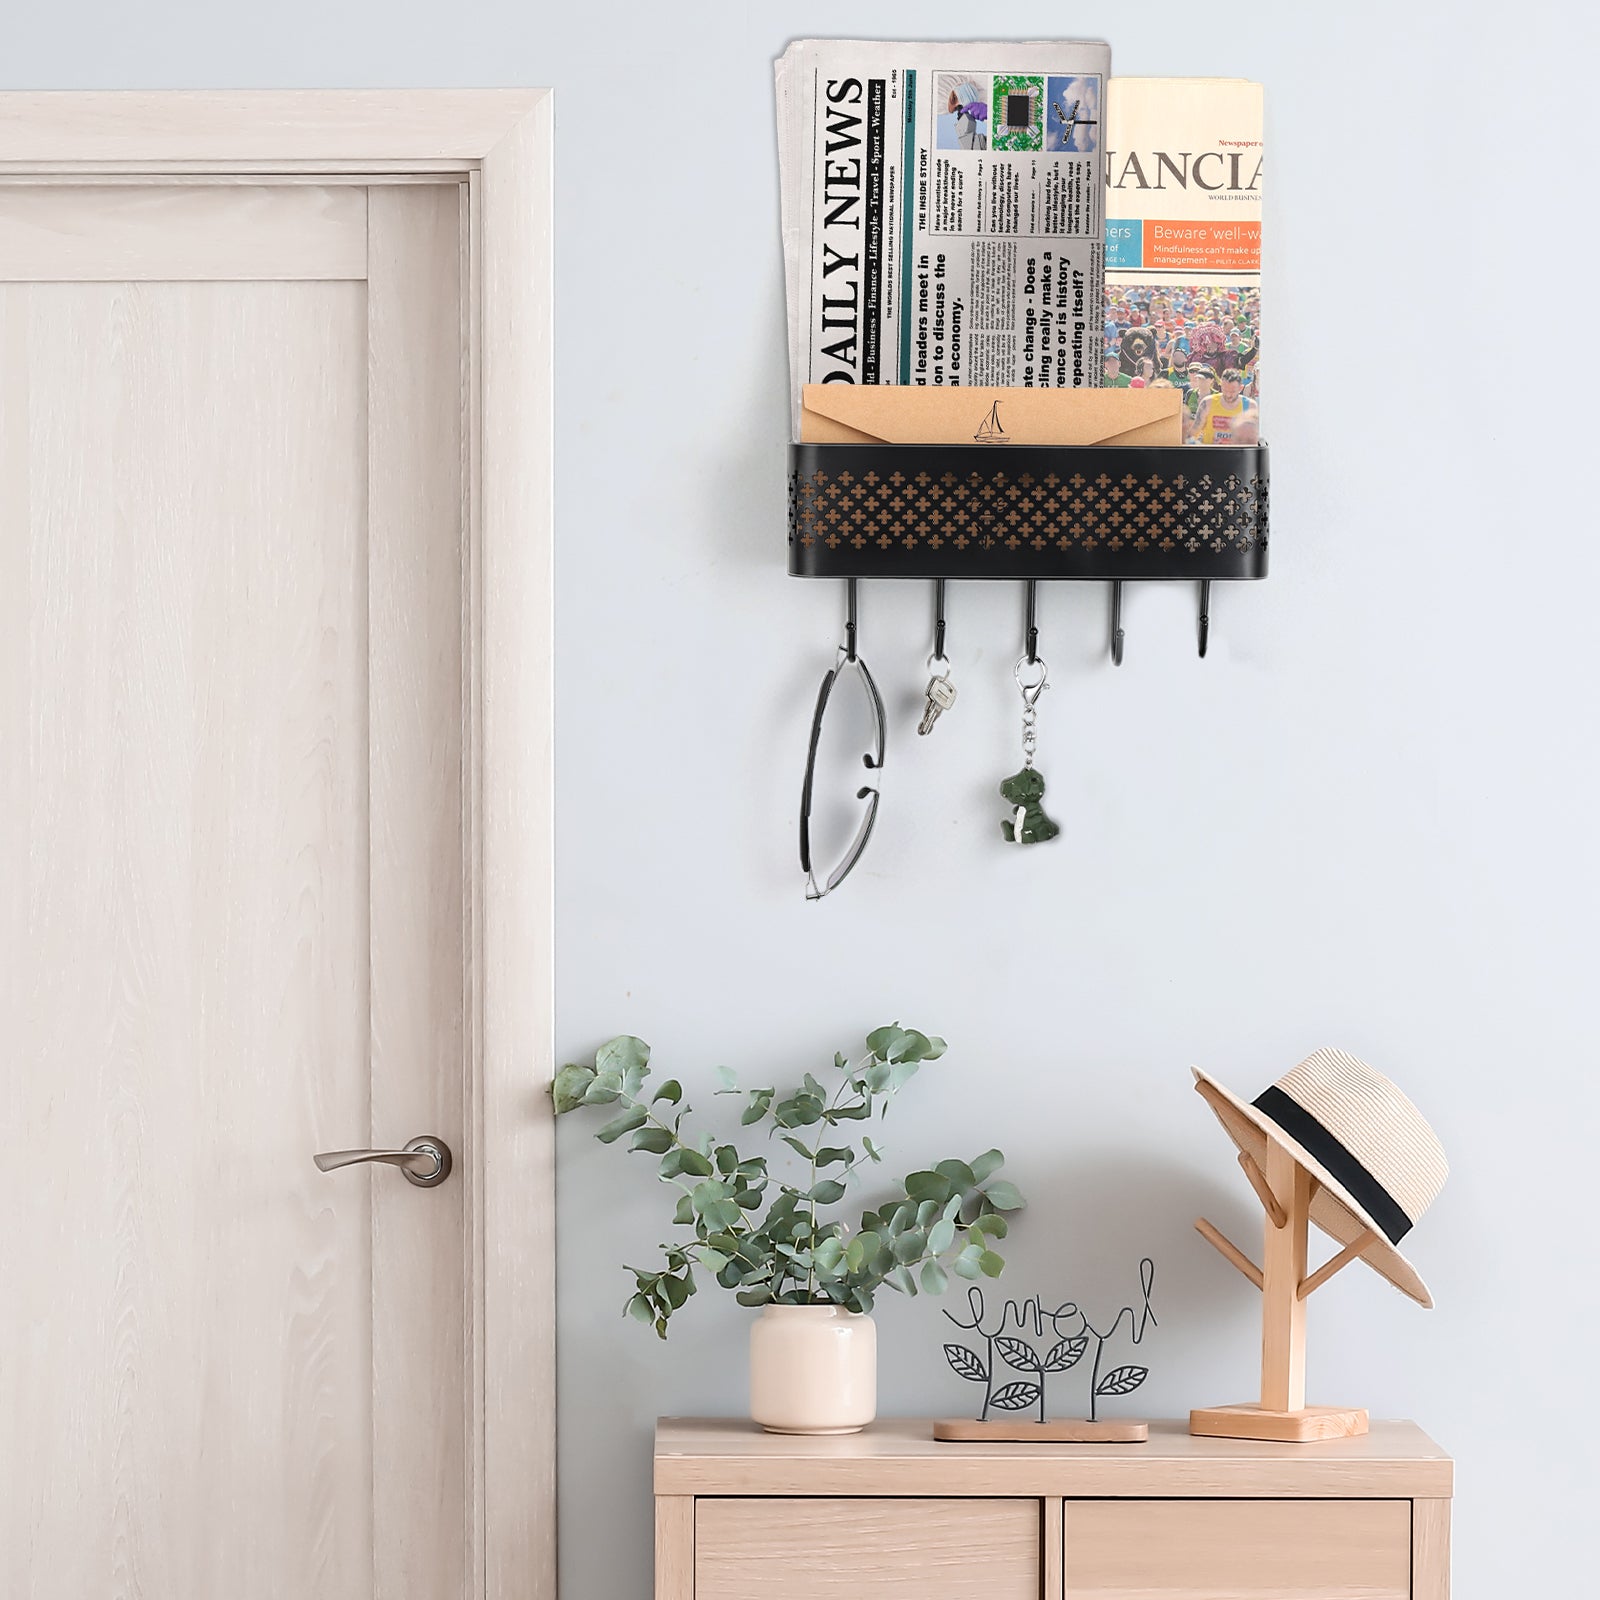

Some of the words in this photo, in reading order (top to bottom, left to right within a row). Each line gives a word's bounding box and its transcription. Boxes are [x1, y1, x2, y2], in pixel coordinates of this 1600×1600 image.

[872, 84, 882, 128] Weather
[824, 78, 862, 230] NEWS
[871, 136, 882, 164] Sport
[1219, 140, 1258, 148] Newspaper
[870, 173, 880, 207] Travel
[869, 216, 880, 260] Lifestyle
[1110, 244, 1119, 252] of
[1154, 225, 1206, 240] Beware
[1154, 244, 1204, 254] Mindfulness
[1226, 246, 1248, 254] make
[918, 256, 928, 269] in
[934, 254, 945, 278] the
[1044, 252, 1051, 260] a
[1154, 256, 1207, 265] management
[868, 268, 878, 309] Finance
[918, 274, 928, 312] meet
[1024, 258, 1035, 294] Does
[1040, 265, 1051, 305] make
[1056, 257, 1070, 308] history
[1072, 270, 1083, 317] itself?
[933, 284, 945, 341] discuss
[1040, 310, 1053, 350] really
[1056, 313, 1066, 325] is
[868, 318, 876, 363] Business
[916, 317, 927, 372] leaders
[951, 298, 964, 370] economy.
[1023, 308, 1036, 362] change
[1058, 329, 1066, 344] or
[933, 346, 944, 361] to
